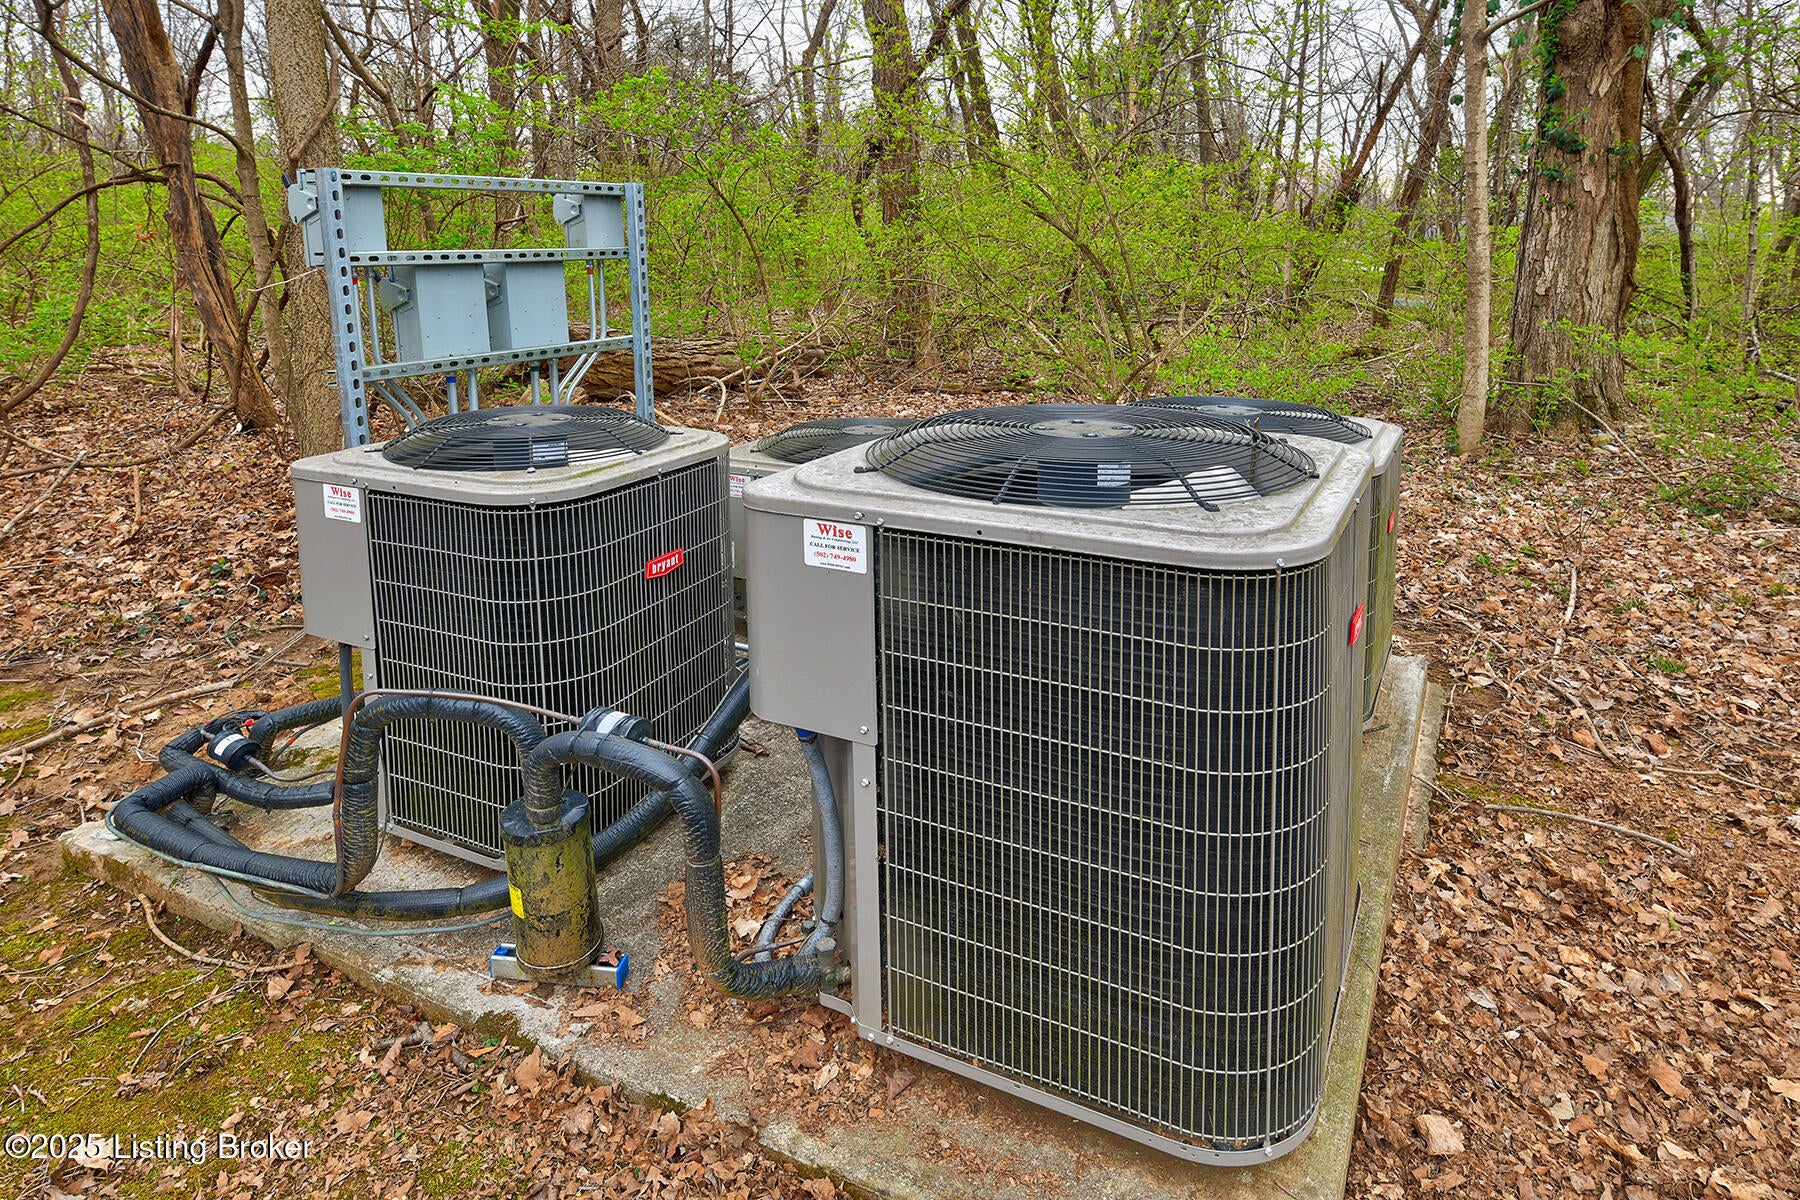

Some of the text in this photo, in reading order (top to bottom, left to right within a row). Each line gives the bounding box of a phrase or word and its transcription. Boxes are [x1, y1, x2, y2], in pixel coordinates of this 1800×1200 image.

[331, 486, 352, 498] Wise
[816, 522, 852, 539] Wise
[837, 545, 860, 553] SERVICE
[652, 554, 678, 574] bryant
